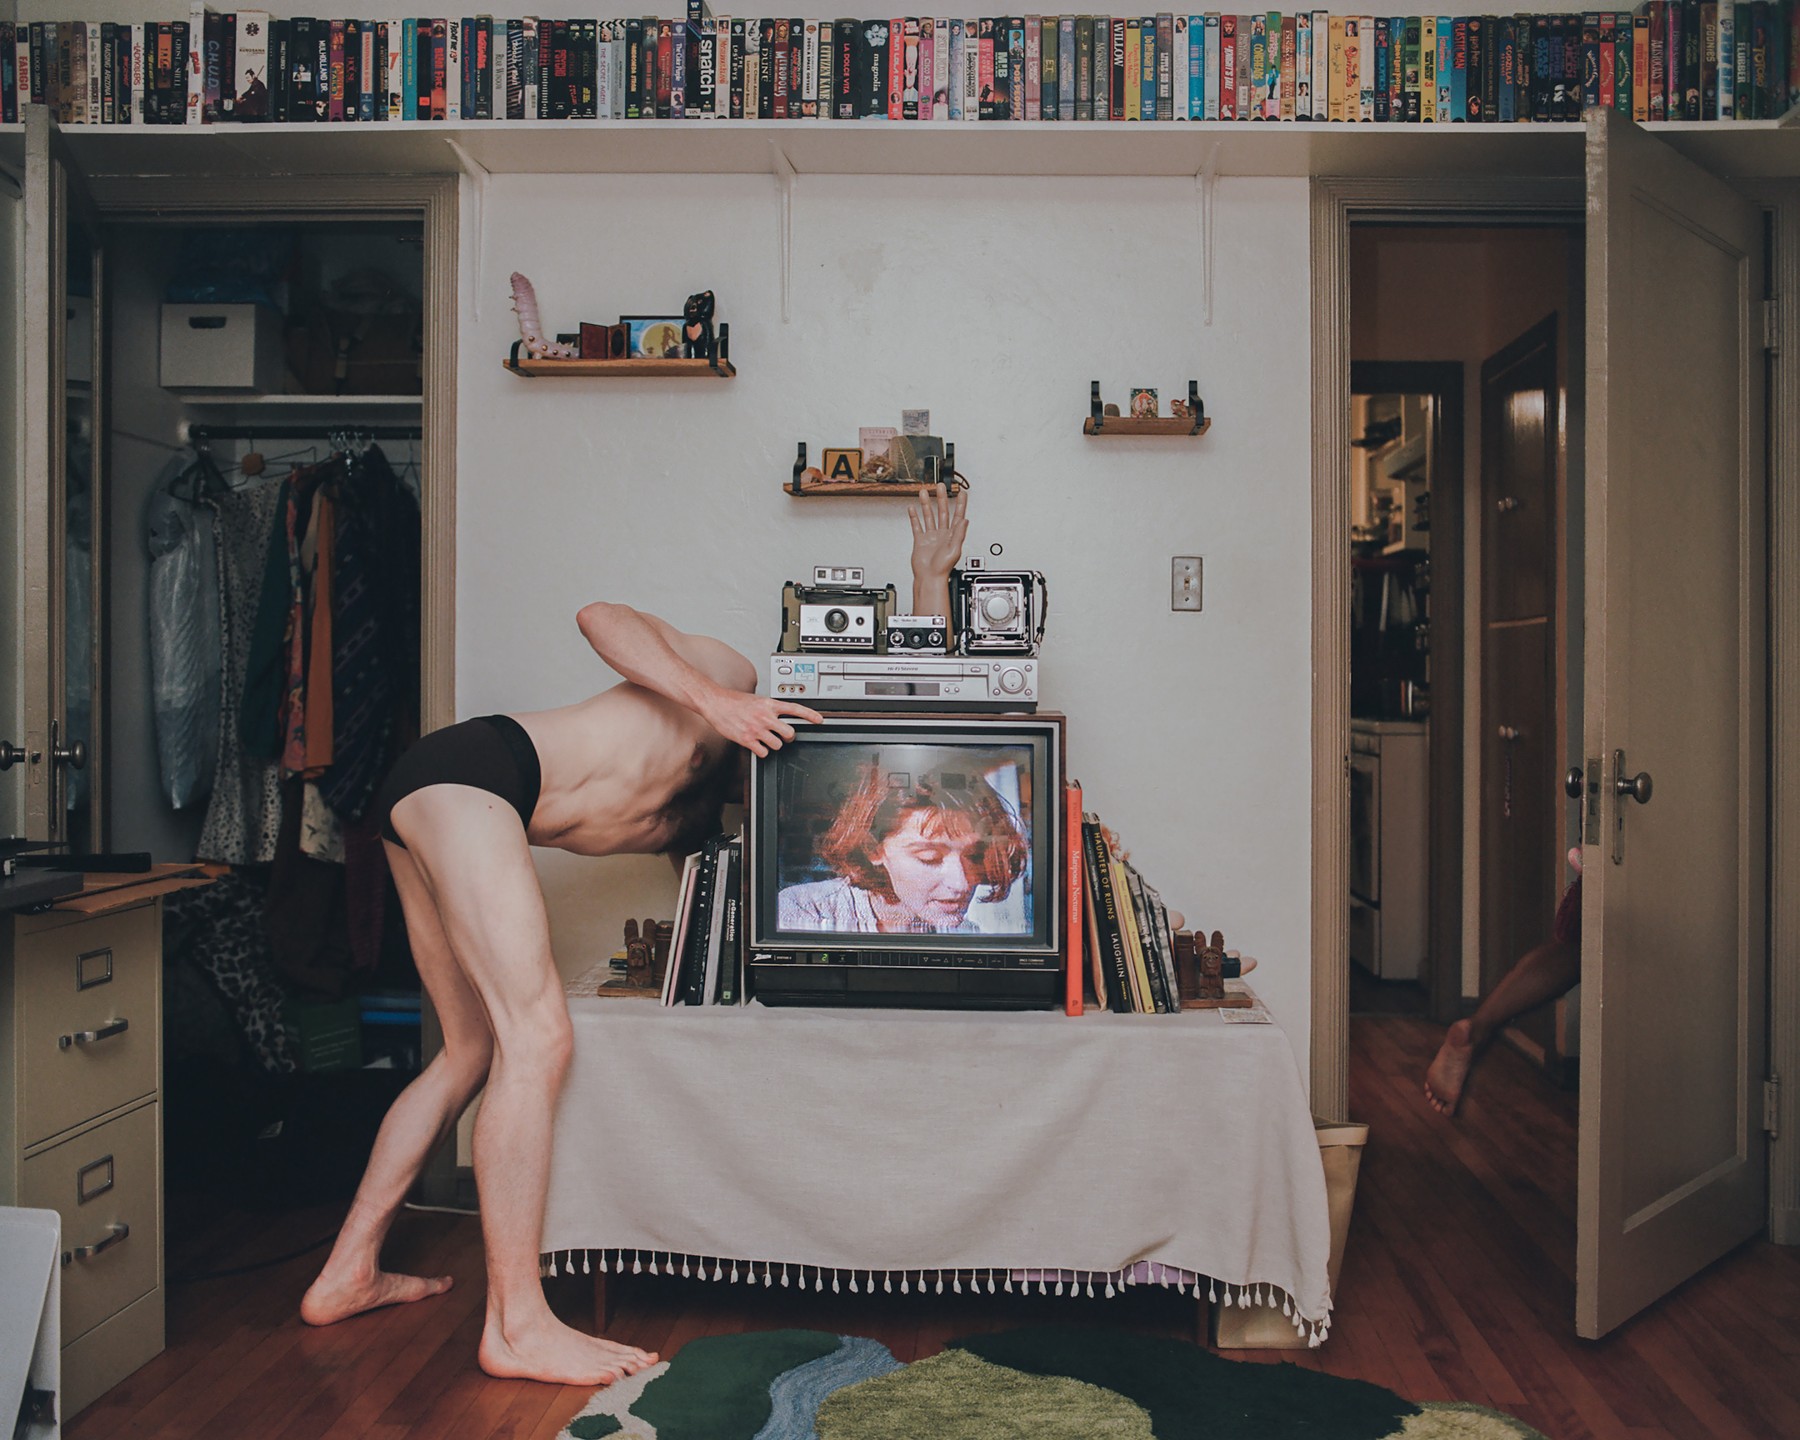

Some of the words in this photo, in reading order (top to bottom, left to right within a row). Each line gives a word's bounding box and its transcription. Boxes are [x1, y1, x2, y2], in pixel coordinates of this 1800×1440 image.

[844, 43, 849, 52] LA
[1114, 22, 1124, 67] WILLOW
[1455, 23, 1465, 50] PLASTIC
[19, 56, 29, 90] FARGO
[208, 40, 220, 89] C.H.U.D.
[554, 49, 566, 76] PSYCHO
[700, 39, 715, 95] snatch
[820, 46, 831, 77] CITIZEN
[871, 53, 880, 92] magnolia
[1045, 59, 1054, 72] E.T.
[1096, 42, 1105, 82] MONONOKE
[1253, 44, 1264, 80] CONEHEADS
[1455, 52, 1465, 69] MAN
[1737, 42, 1746, 83] FLUBBER
[1752, 47, 1766, 87] TOTORO
[819, 78, 830, 100] KANE
[1225, 76, 1233, 90] TALE
[831, 454, 855, 479] A
[1094, 832, 1107, 874] HAUNTER
[700, 855, 711, 908] MAINE
[1101, 877, 1110, 889] OF
[1072, 887, 1080, 924] Nocturnas
[1104, 893, 1115, 920] RUINS
[822, 953, 828, 961] 2
[1111, 933, 1125, 978] LAUGHLIN
